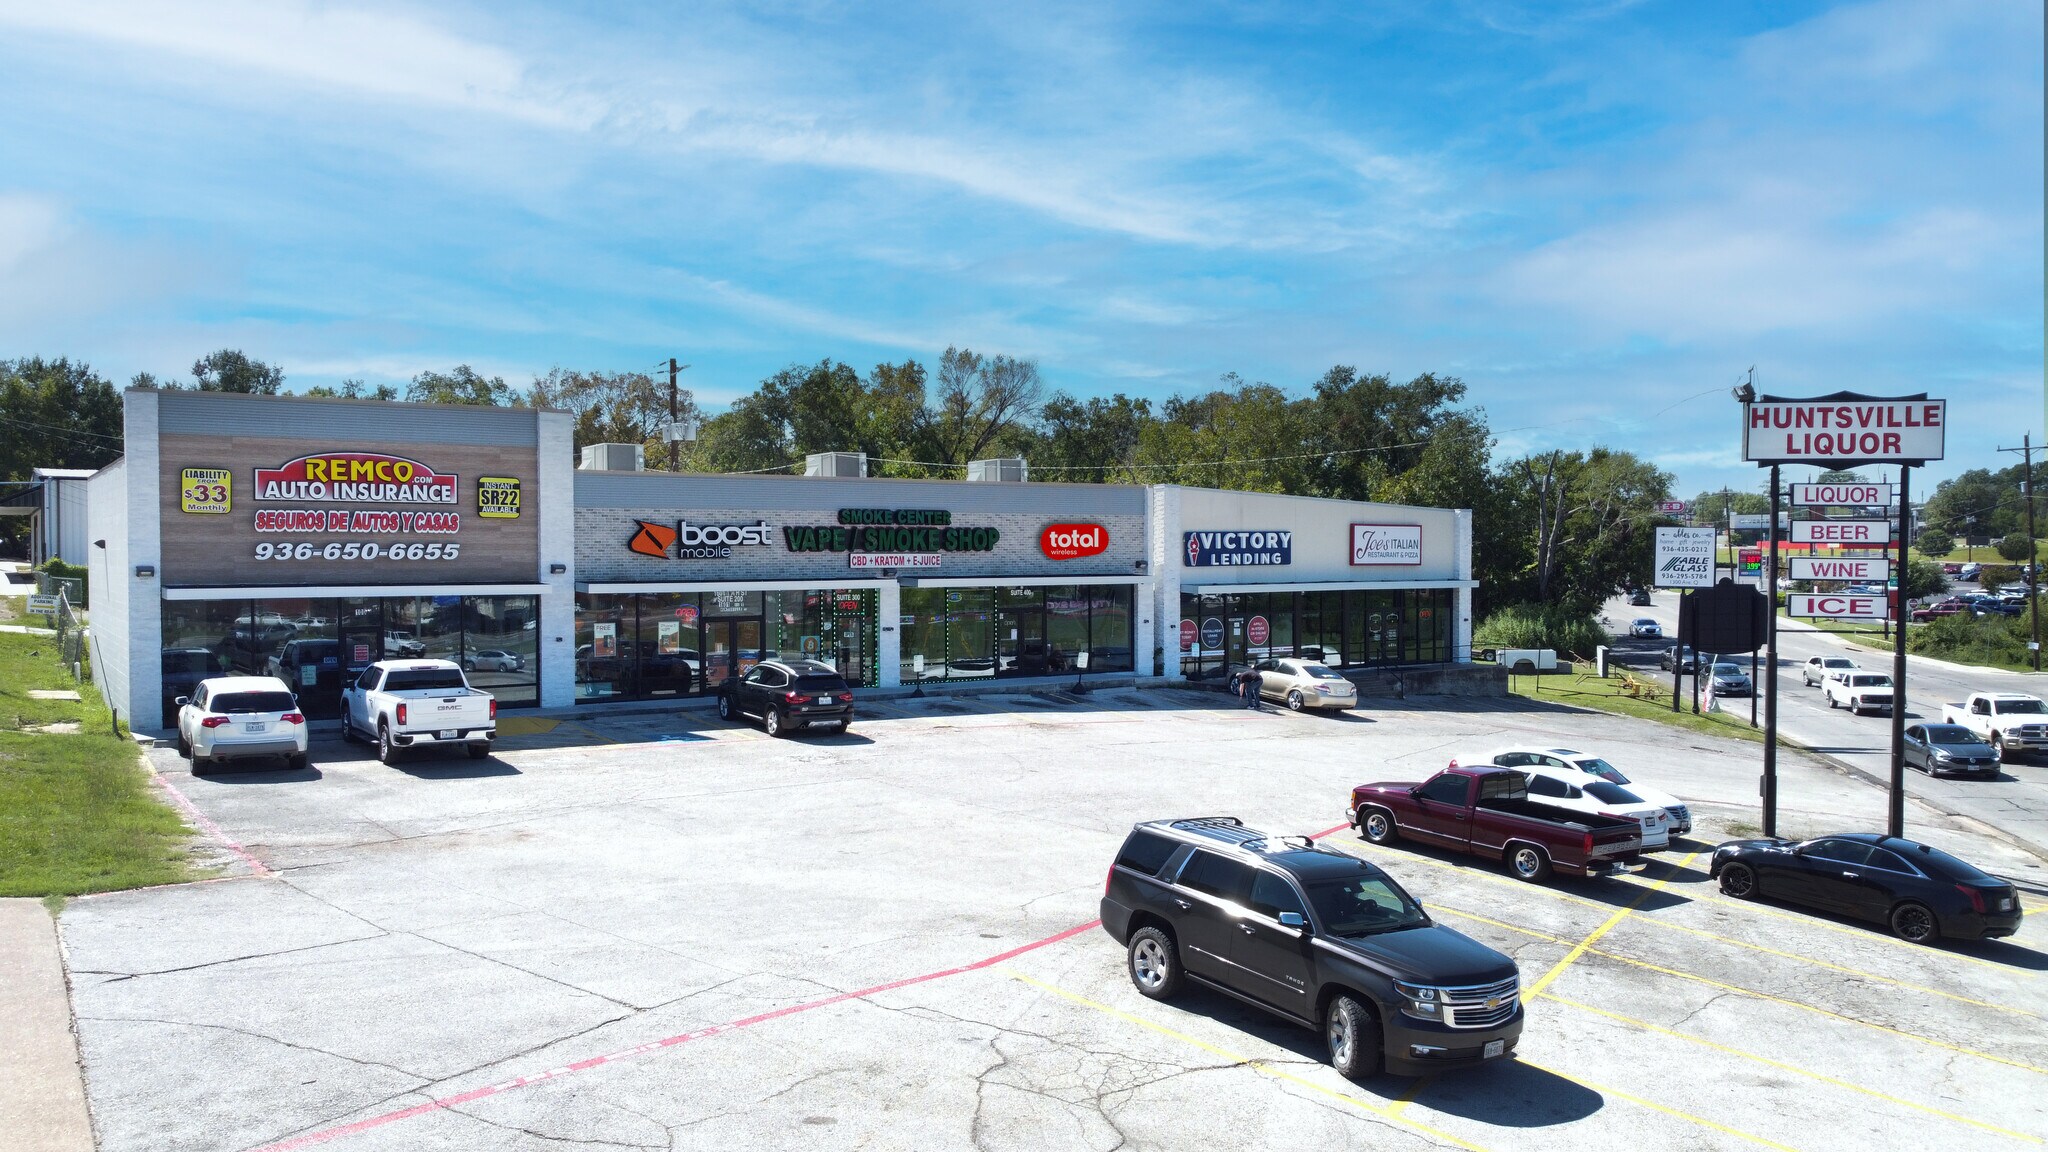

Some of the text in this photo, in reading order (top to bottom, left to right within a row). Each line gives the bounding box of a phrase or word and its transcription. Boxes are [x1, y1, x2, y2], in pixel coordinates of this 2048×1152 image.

[1751, 405, 1941, 429] HUNTSVILLE
[1786, 432, 1902, 456] LIQUOR
[185, 470, 228, 479] LIABILITY
[305, 458, 414, 483] REMCO
[184, 484, 228, 503] $33
[264, 481, 452, 502] AUTO INSURANCE
[1804, 486, 1878, 503] LIQUOR
[187, 504, 227, 512] Monthly
[255, 510, 460, 533] SEGUROS DE AUTOS Y CASAS
[839, 509, 952, 525] SMOKE CENTER
[681, 521, 773, 546] boost
[785, 527, 846, 551] VAPE
[864, 527, 940, 551] SMOKE
[944, 527, 1000, 551] SHOP
[1050, 528, 1099, 548] total
[1200, 532, 1292, 549] VICTORY
[1810, 525, 1869, 540] BEER
[254, 542, 460, 561] 936-650-6655
[680, 545, 731, 558] mobile
[1356, 530, 1419, 560] Joe's ITALIAN
[851, 556, 867, 566] CBD
[874, 556, 905, 566] KRATOM
[913, 556, 941, 566] E-JUICE
[1210, 552, 1282, 566] LENDING
[1811, 562, 1868, 577] WINE
[675, 608, 697, 617] OPEN
[839, 601, 858, 610] OPEN
[1807, 598, 1873, 614] ICE
